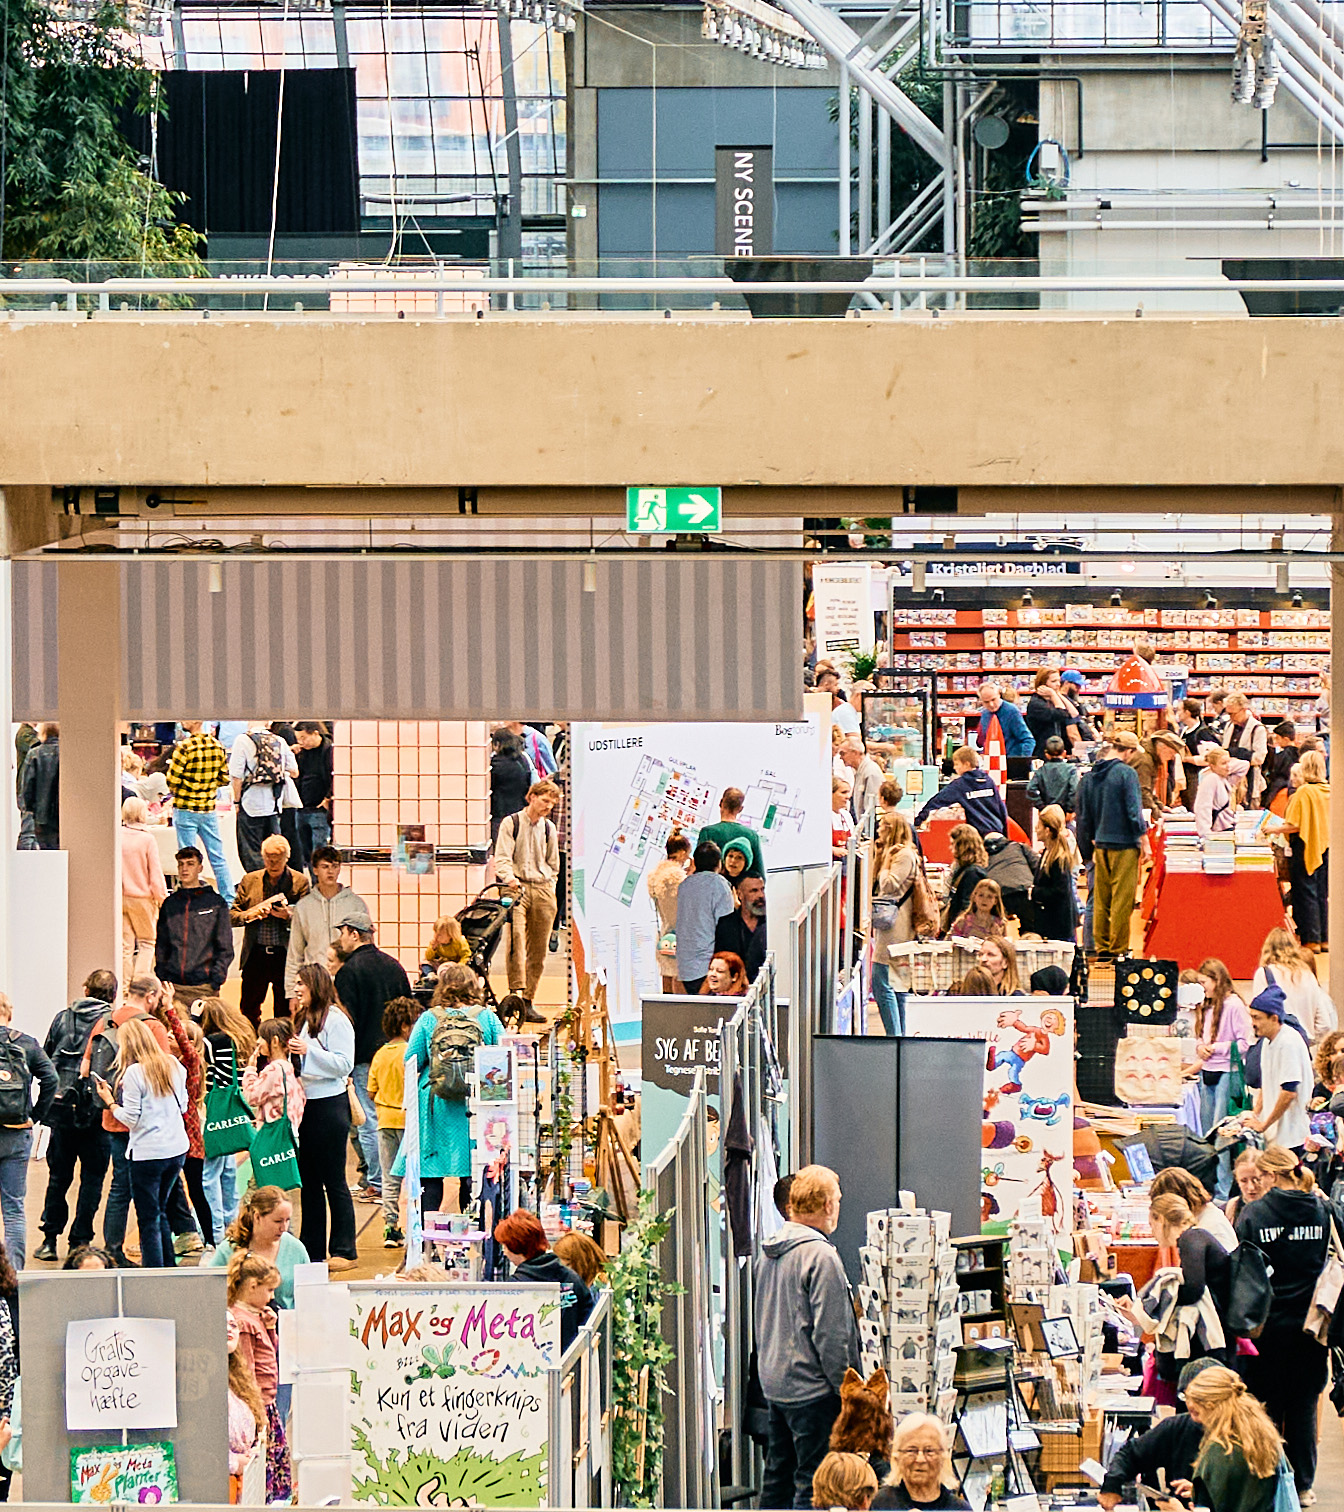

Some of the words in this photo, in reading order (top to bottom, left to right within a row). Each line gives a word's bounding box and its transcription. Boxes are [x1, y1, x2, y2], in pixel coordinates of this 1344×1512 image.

[734, 152, 754, 183] NY
[734, 187, 754, 257] SCENE
[932, 561, 1005, 576] Kristeligt
[1006, 562, 1067, 576] Dagblad
[589, 736, 643, 751] UDSTILLERE
[654, 1037, 678, 1060] SYG
[683, 1039, 700, 1061] AF
[705, 1040, 720, 1062] BE
[361, 1301, 424, 1350] Max
[429, 1316, 455, 1336] og
[460, 1300, 535, 1349] Meta
[84, 1330, 136, 1363] Gratis
[81, 1361, 148, 1390] opgave-
[89, 1387, 142, 1413] hæfte
[377, 1386, 410, 1412] Kun
[419, 1385, 435, 1408] et
[441, 1384, 542, 1420] fingerknips
[397, 1413, 428, 1441] fra
[439, 1413, 510, 1442] viden
